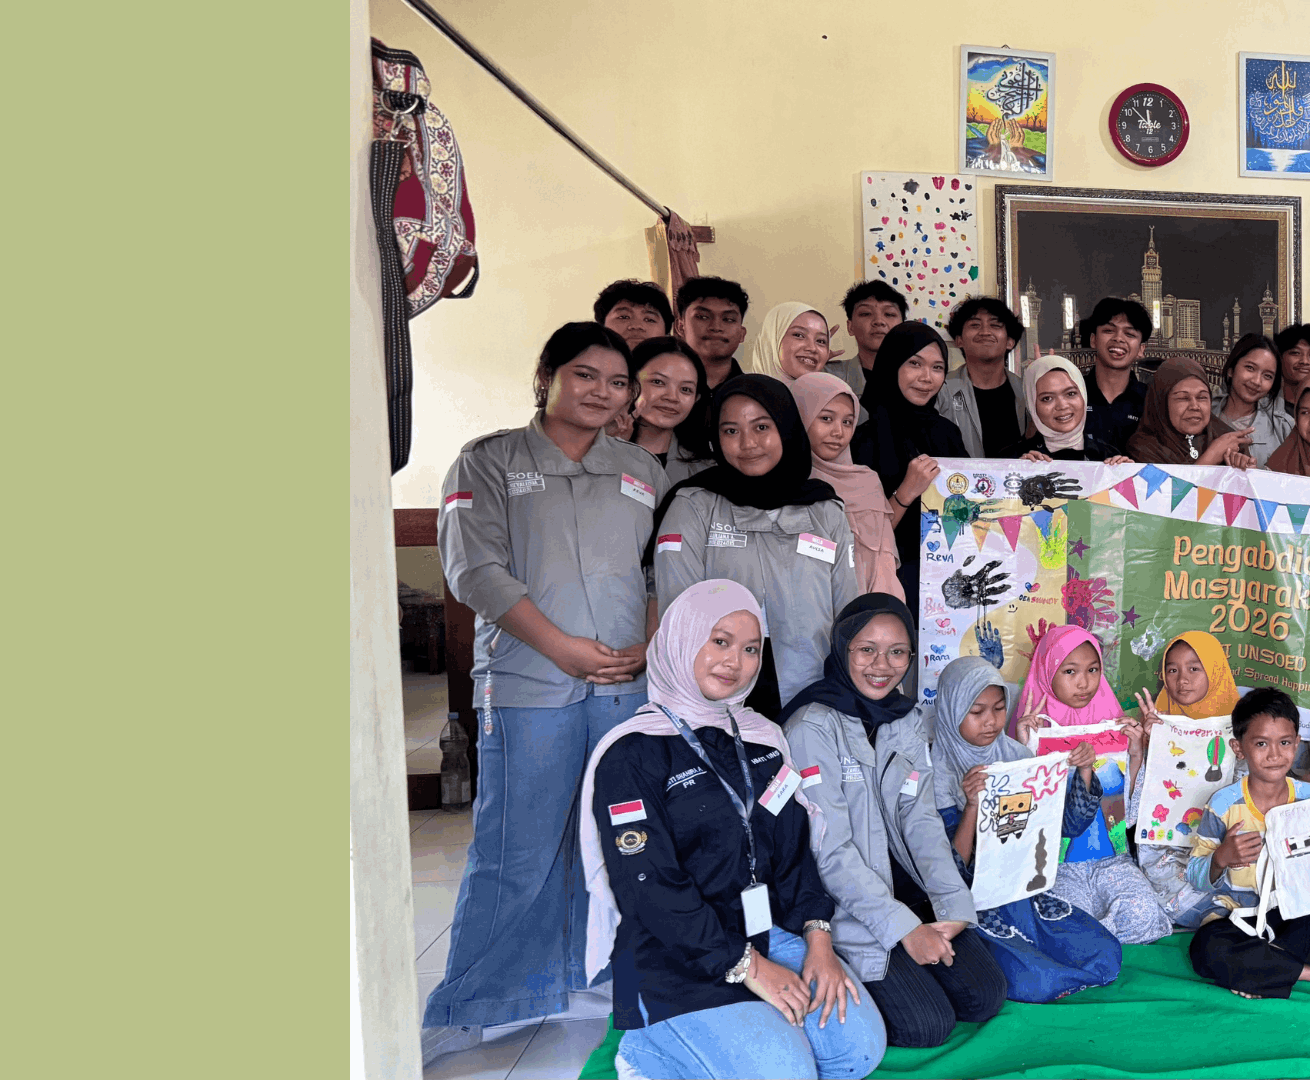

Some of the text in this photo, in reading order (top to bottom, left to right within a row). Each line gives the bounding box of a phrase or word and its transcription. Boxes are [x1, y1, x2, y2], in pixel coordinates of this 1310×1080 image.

[1133, 99, 1139, 107] 11
[1143, 97, 1154, 107] 12
[1159, 100, 1163, 108] 1
[1124, 108, 1133, 117] 10
[1121, 121, 1127, 129] 9
[1171, 122, 1176, 130] 3
[1125, 134, 1131, 142] 8
[1148, 145, 1153, 153] 6
[1160, 143, 1166, 151] 5
[507, 471, 543, 480] SOED
[1209, 603, 1292, 641] 2026
[1237, 643, 1308, 672] UNSOED
[1244, 667, 1280, 684] Spread
[767, 750, 780, 759] UNS
[683, 778, 696, 789] PR
